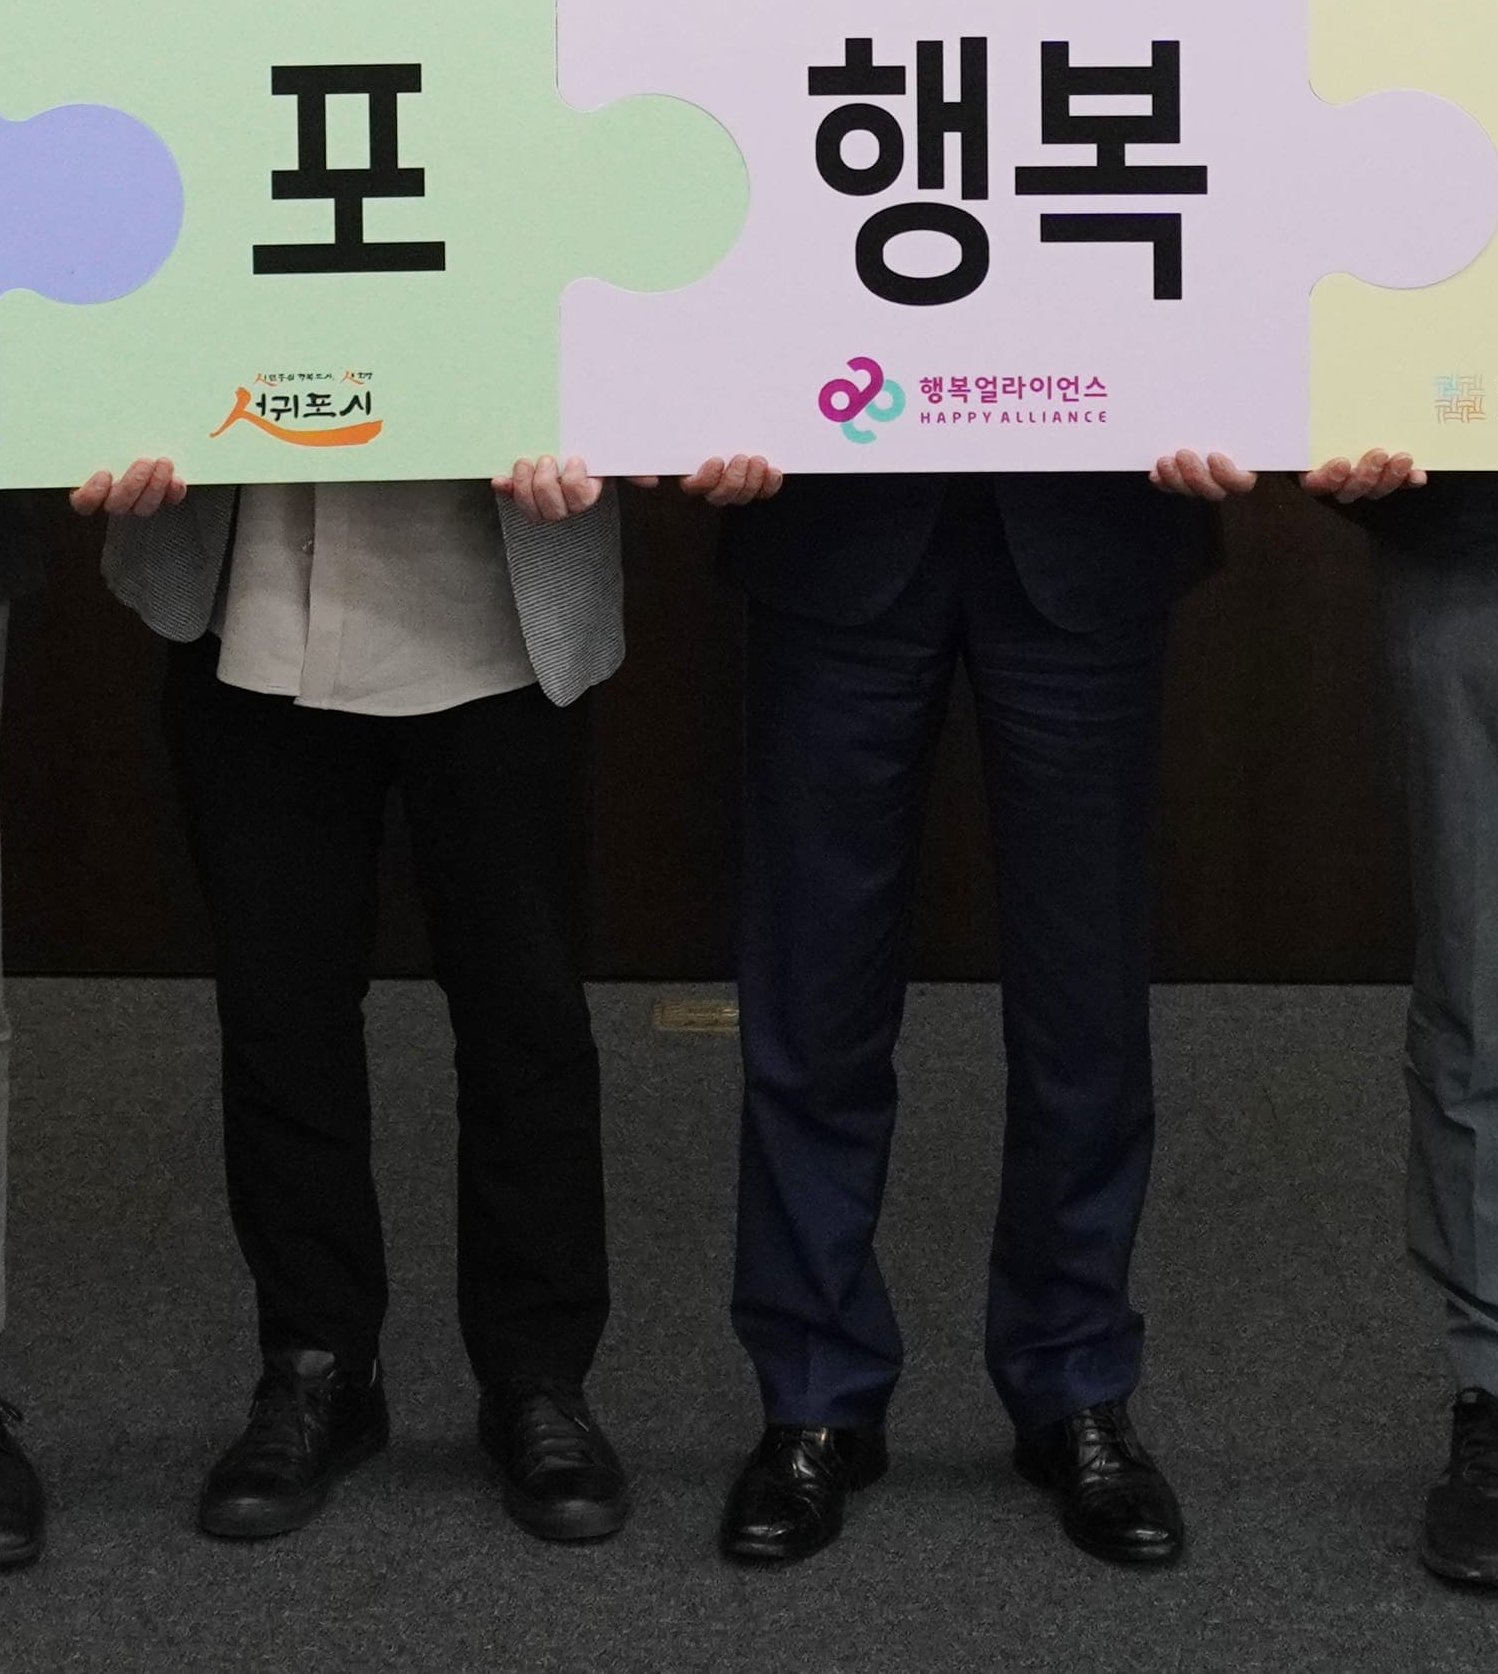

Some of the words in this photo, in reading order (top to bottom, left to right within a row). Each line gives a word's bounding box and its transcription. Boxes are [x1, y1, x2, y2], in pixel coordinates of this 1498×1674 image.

[252, 61, 448, 277] 포
[807, 36, 1210, 308] 행복
[918, 375, 1109, 405] 행복얼라이언스
[209, 386, 384, 448] 서귀포시
[919, 410, 992, 425] HAPPY
[1001, 410, 1108, 424] ALLIANCE
